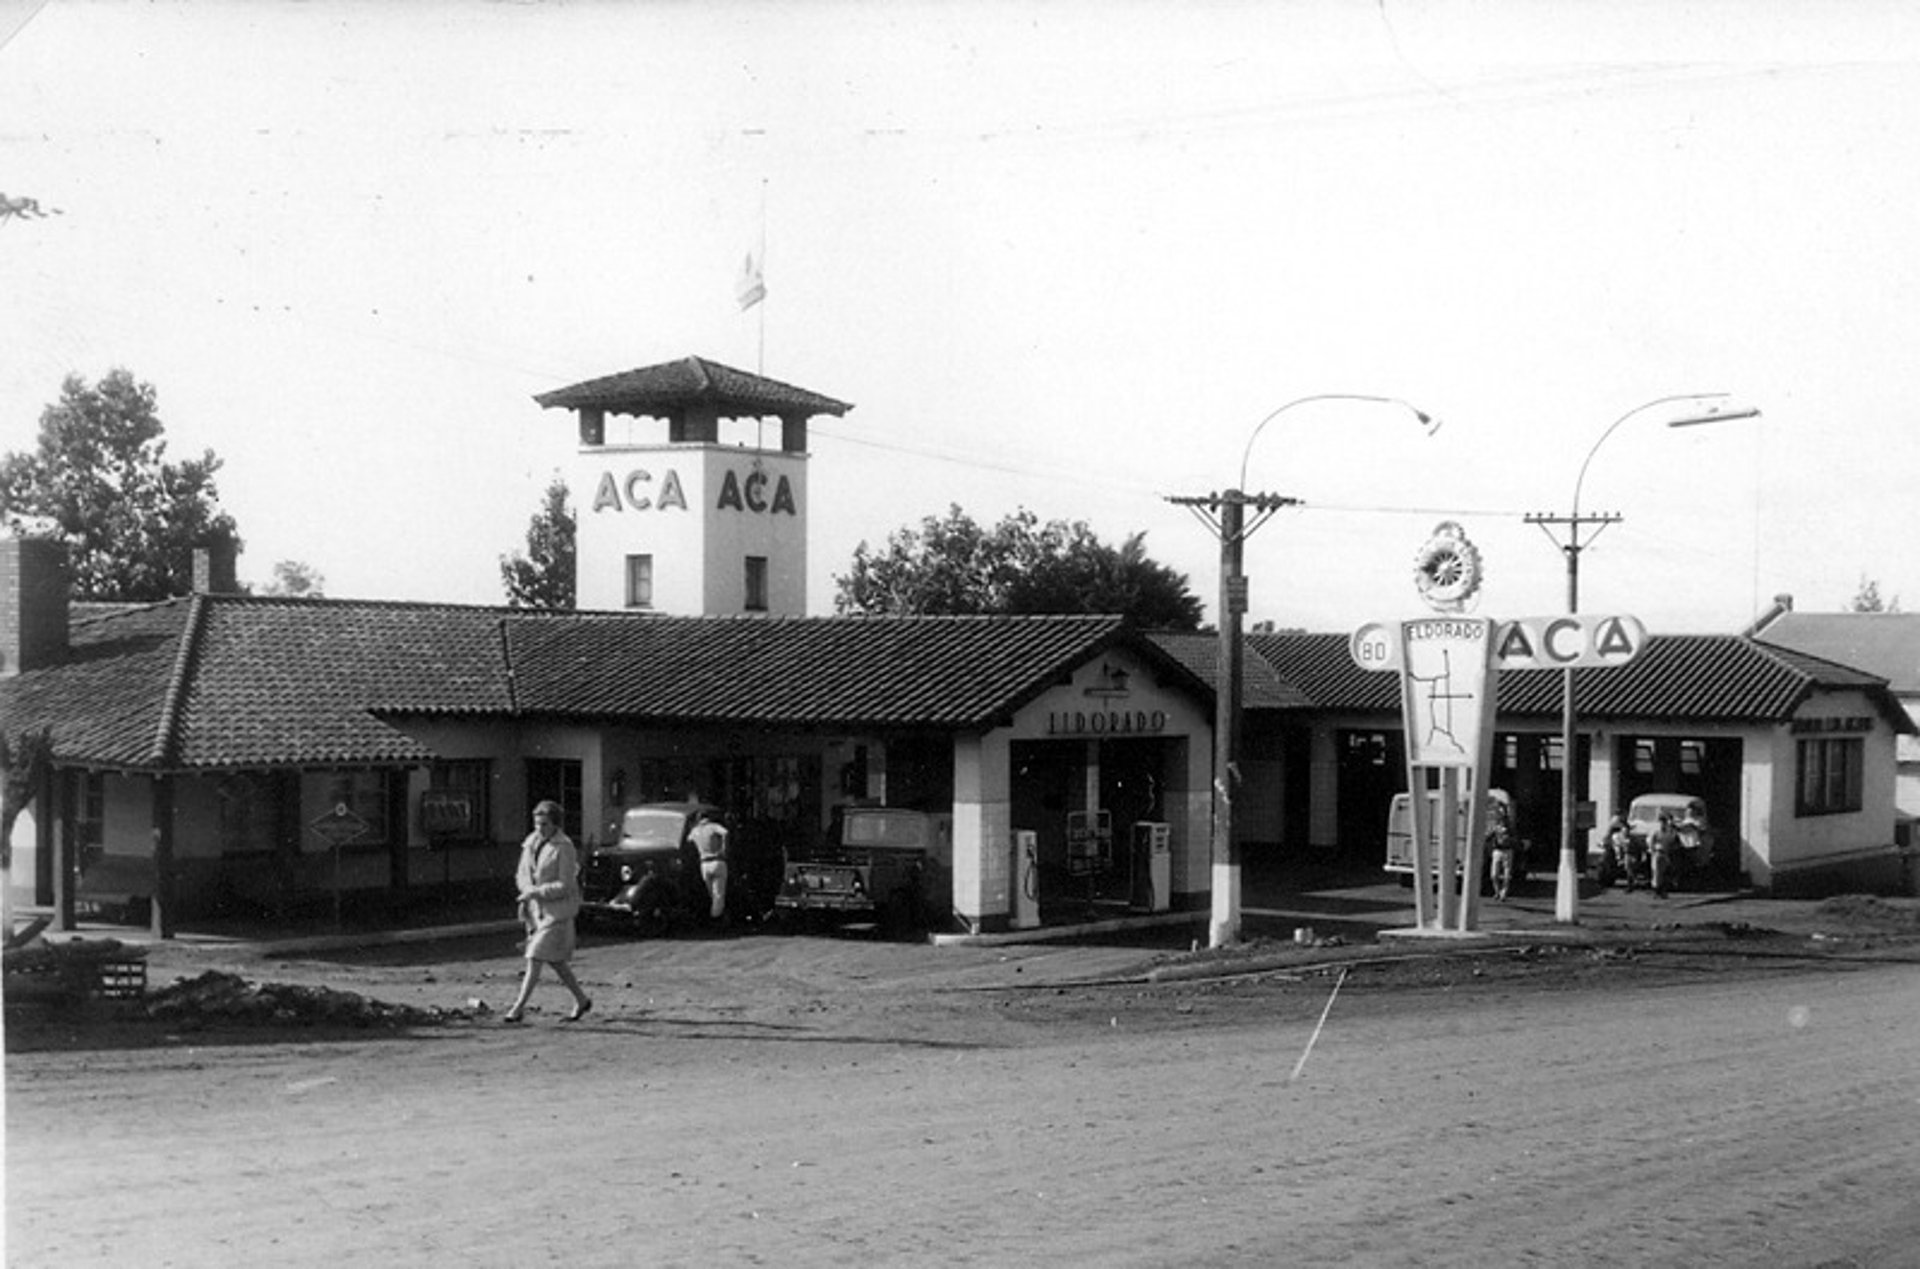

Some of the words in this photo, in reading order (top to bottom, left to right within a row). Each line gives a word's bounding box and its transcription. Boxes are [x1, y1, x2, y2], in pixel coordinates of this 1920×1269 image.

[593, 469, 688, 514] ACA
[717, 469, 796, 516] ACA
[1406, 622, 1484, 641] ELDORADO
[1497, 617, 1634, 662] ACA
